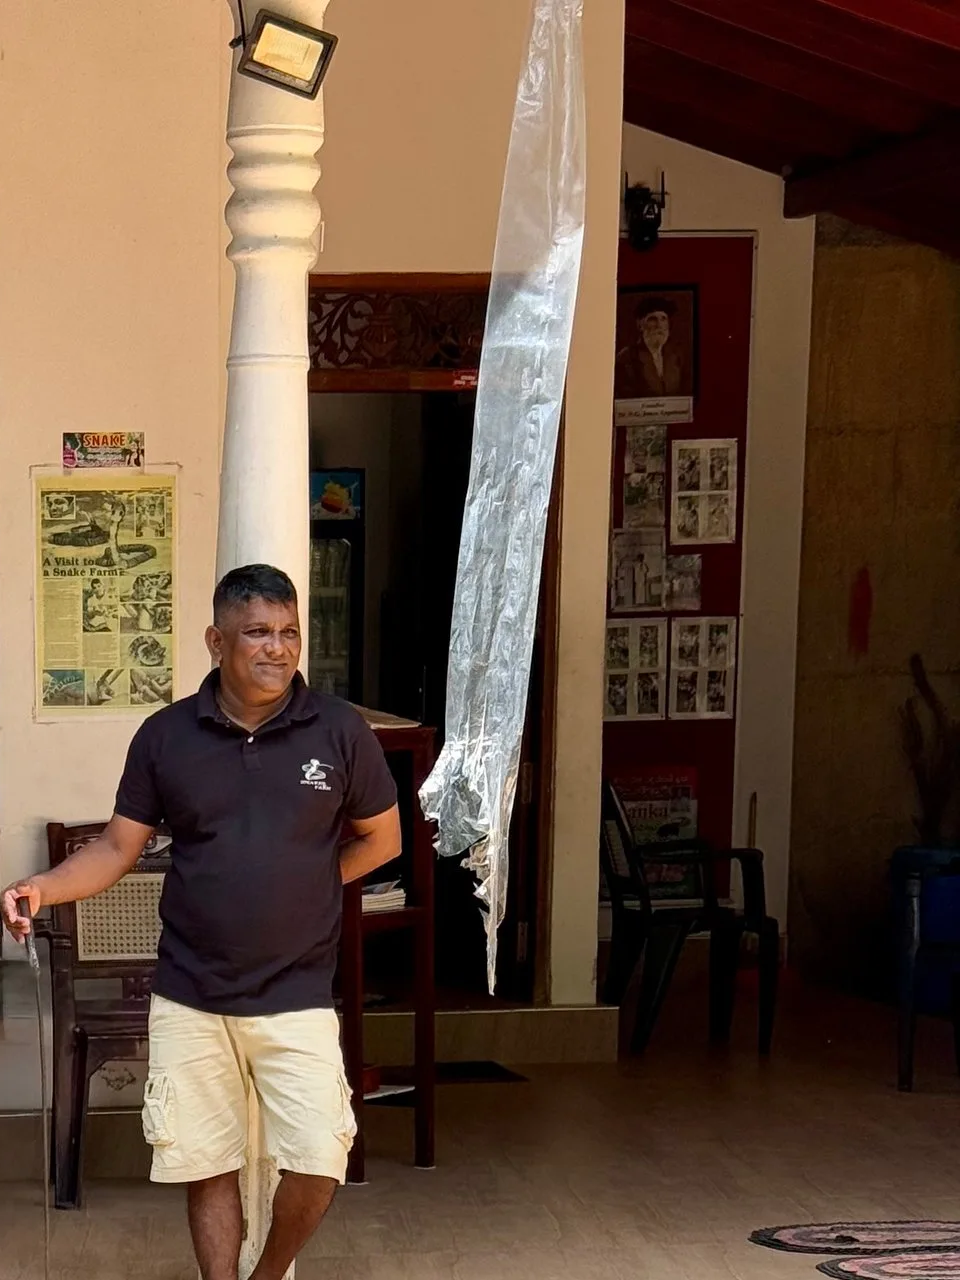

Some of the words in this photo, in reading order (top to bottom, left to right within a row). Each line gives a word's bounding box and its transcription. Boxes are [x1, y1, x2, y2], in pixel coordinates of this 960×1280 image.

[84, 434, 126, 447] SNAKE
[43, 557, 52, 566] A
[54, 557, 80, 566] Visit
[83, 557, 95, 566] to
[43, 569, 50, 577] a
[53, 567, 86, 577] Snake
